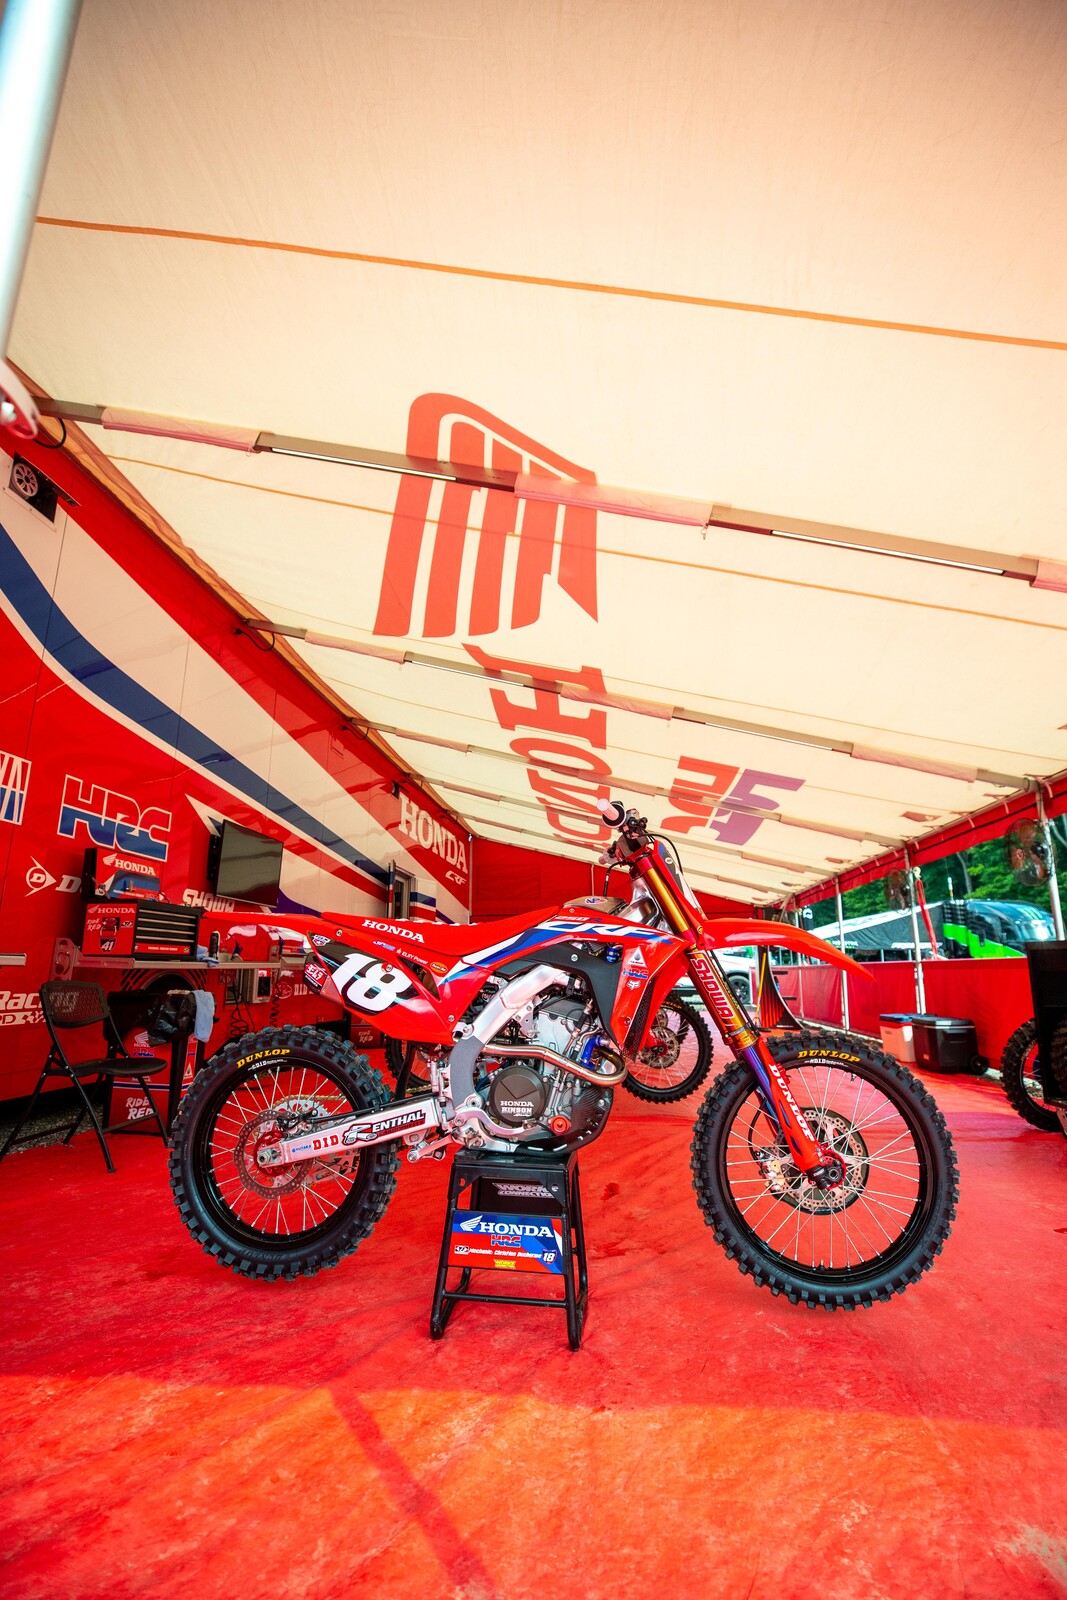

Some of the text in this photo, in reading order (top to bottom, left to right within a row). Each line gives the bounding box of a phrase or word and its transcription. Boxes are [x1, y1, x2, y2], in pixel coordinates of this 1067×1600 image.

[57, 774, 172, 862] HRC
[399, 791, 468, 875] HONDA
[115, 858, 156, 876] HONDA
[445, 870, 467, 885] CRF
[183, 888, 235, 912] SHOWA
[362, 919, 425, 943] HONDA
[535, 921, 656, 936] CRF
[101, 941, 115, 951] 41
[331, 953, 412, 1011] 18
[691, 957, 735, 1019] SHOWA
[236, 1048, 291, 1068] DUNLOP
[797, 1049, 861, 1063] DUNLOP
[501, 1106, 533, 1114] HINSON
[768, 1063, 815, 1143] DUNLOP
[479, 1222, 554, 1238] HONDA
[490, 1234, 521, 1248] HRC
[543, 1252, 555, 1262] 18
